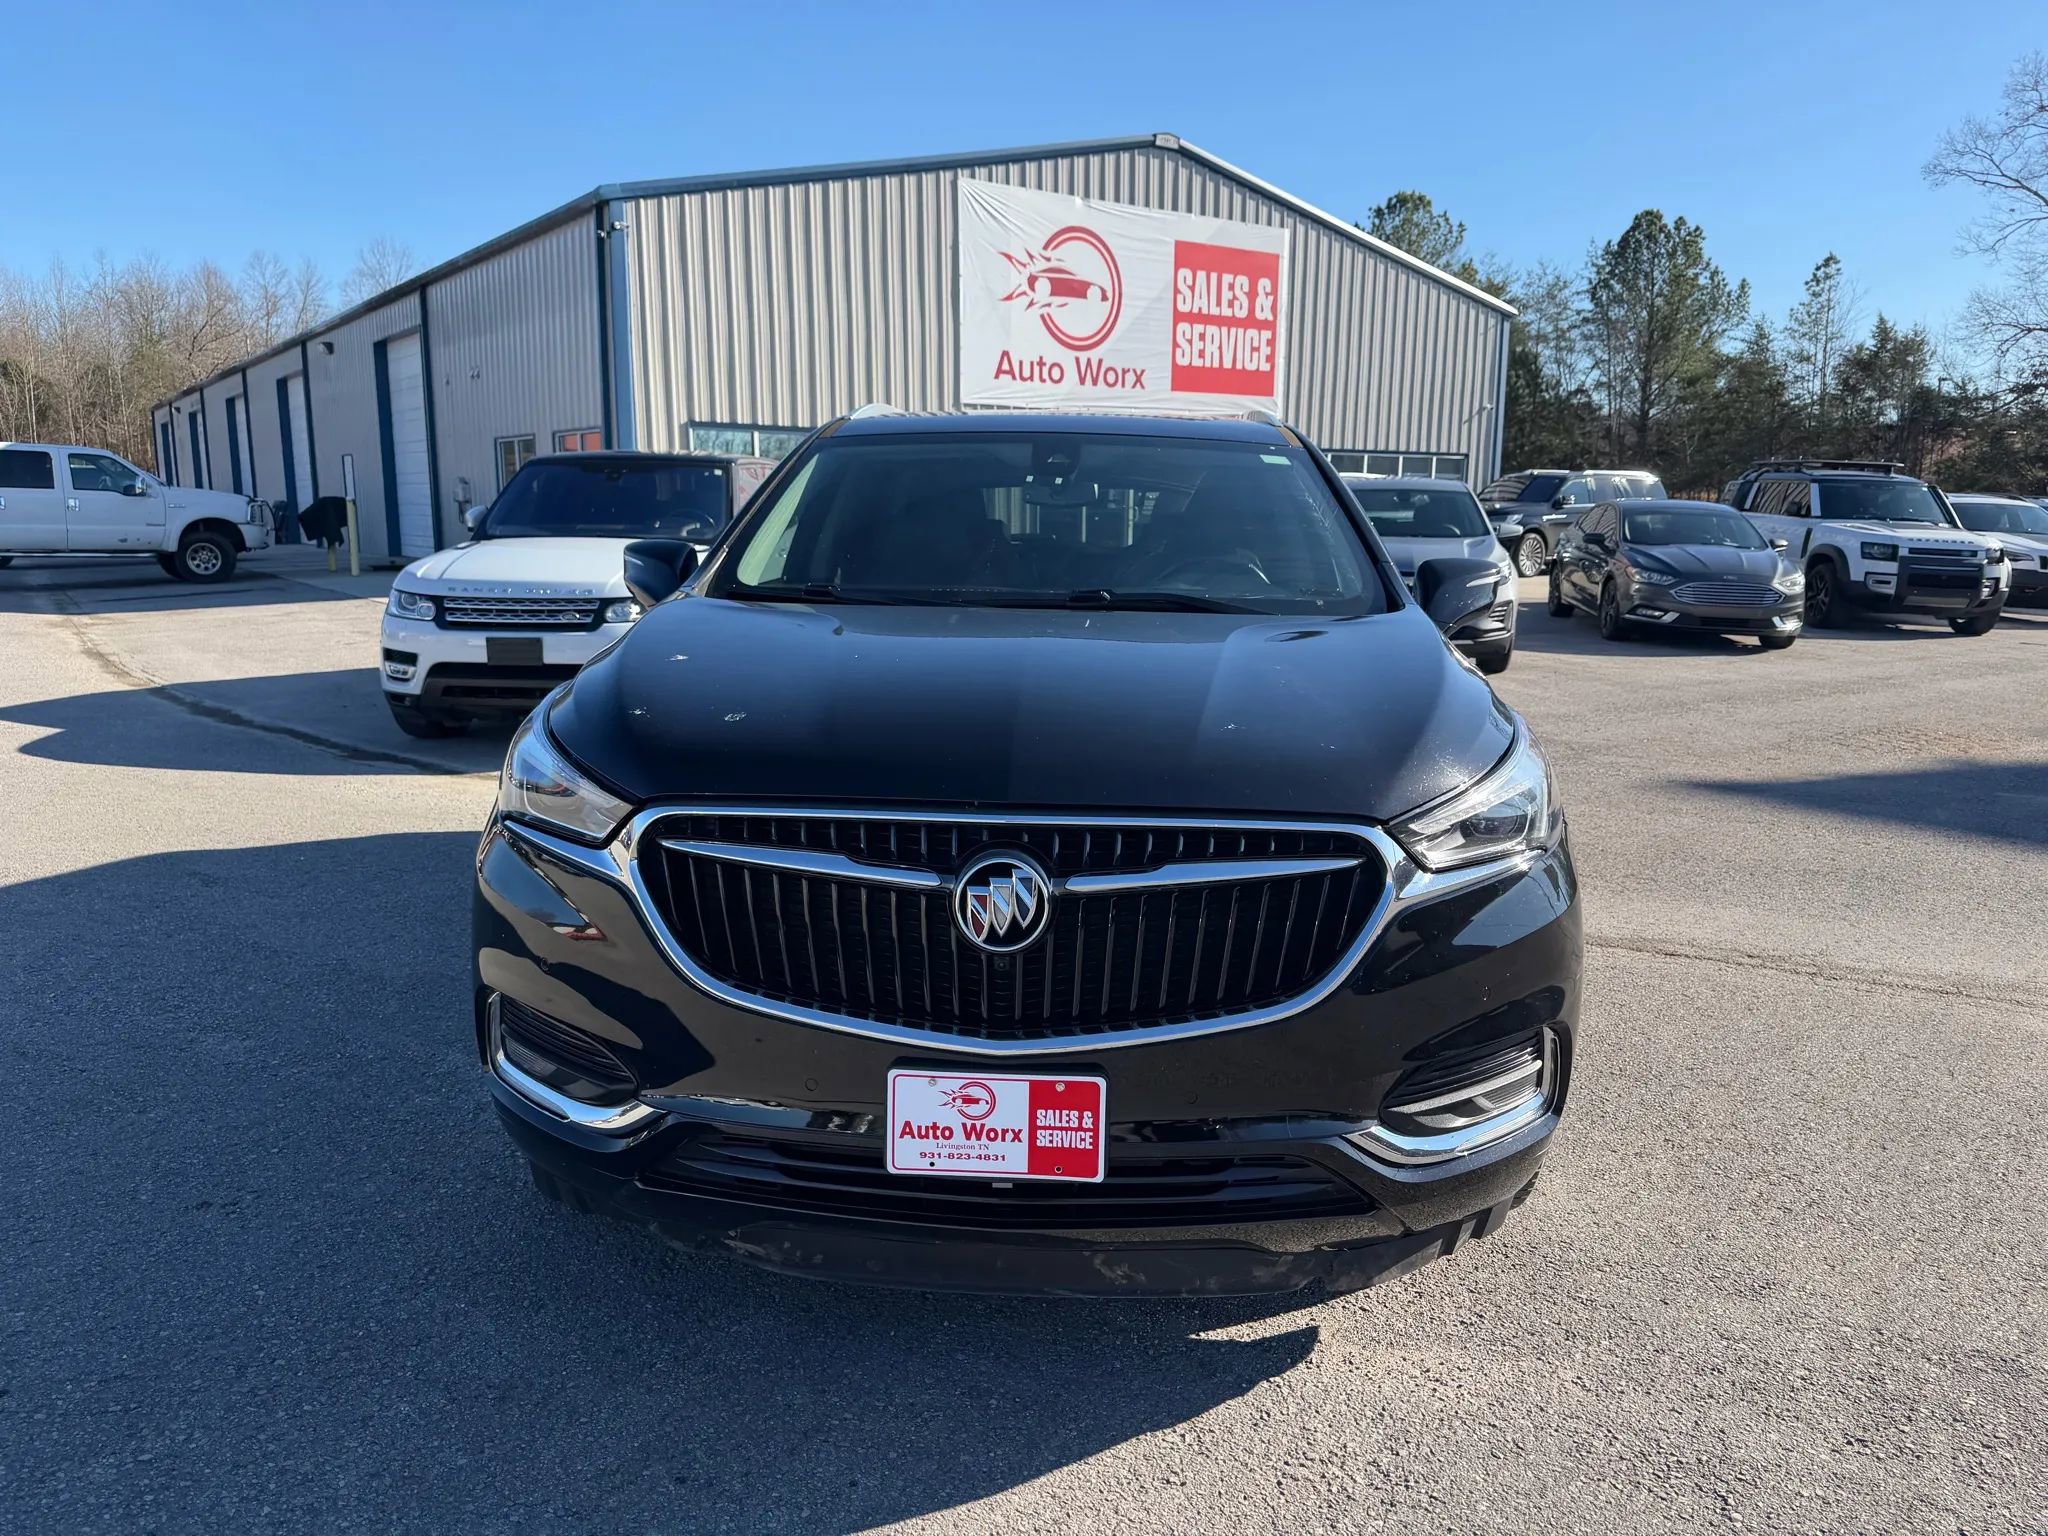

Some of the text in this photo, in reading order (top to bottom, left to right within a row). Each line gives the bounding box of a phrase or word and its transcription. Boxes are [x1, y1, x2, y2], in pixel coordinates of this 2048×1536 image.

[1176, 267, 1274, 321] SALES &
[1175, 321, 1273, 372] SERVICE
[993, 350, 1147, 390] Auto Worx
[1036, 1109, 1094, 1129] SALES &
[899, 1120, 1024, 1143] Auto Worx
[1036, 1129, 1094, 1149] SERVICE
[919, 1152, 1006, 1161] 931-823-4831
[936, 1142, 976, 1151] Livingston
